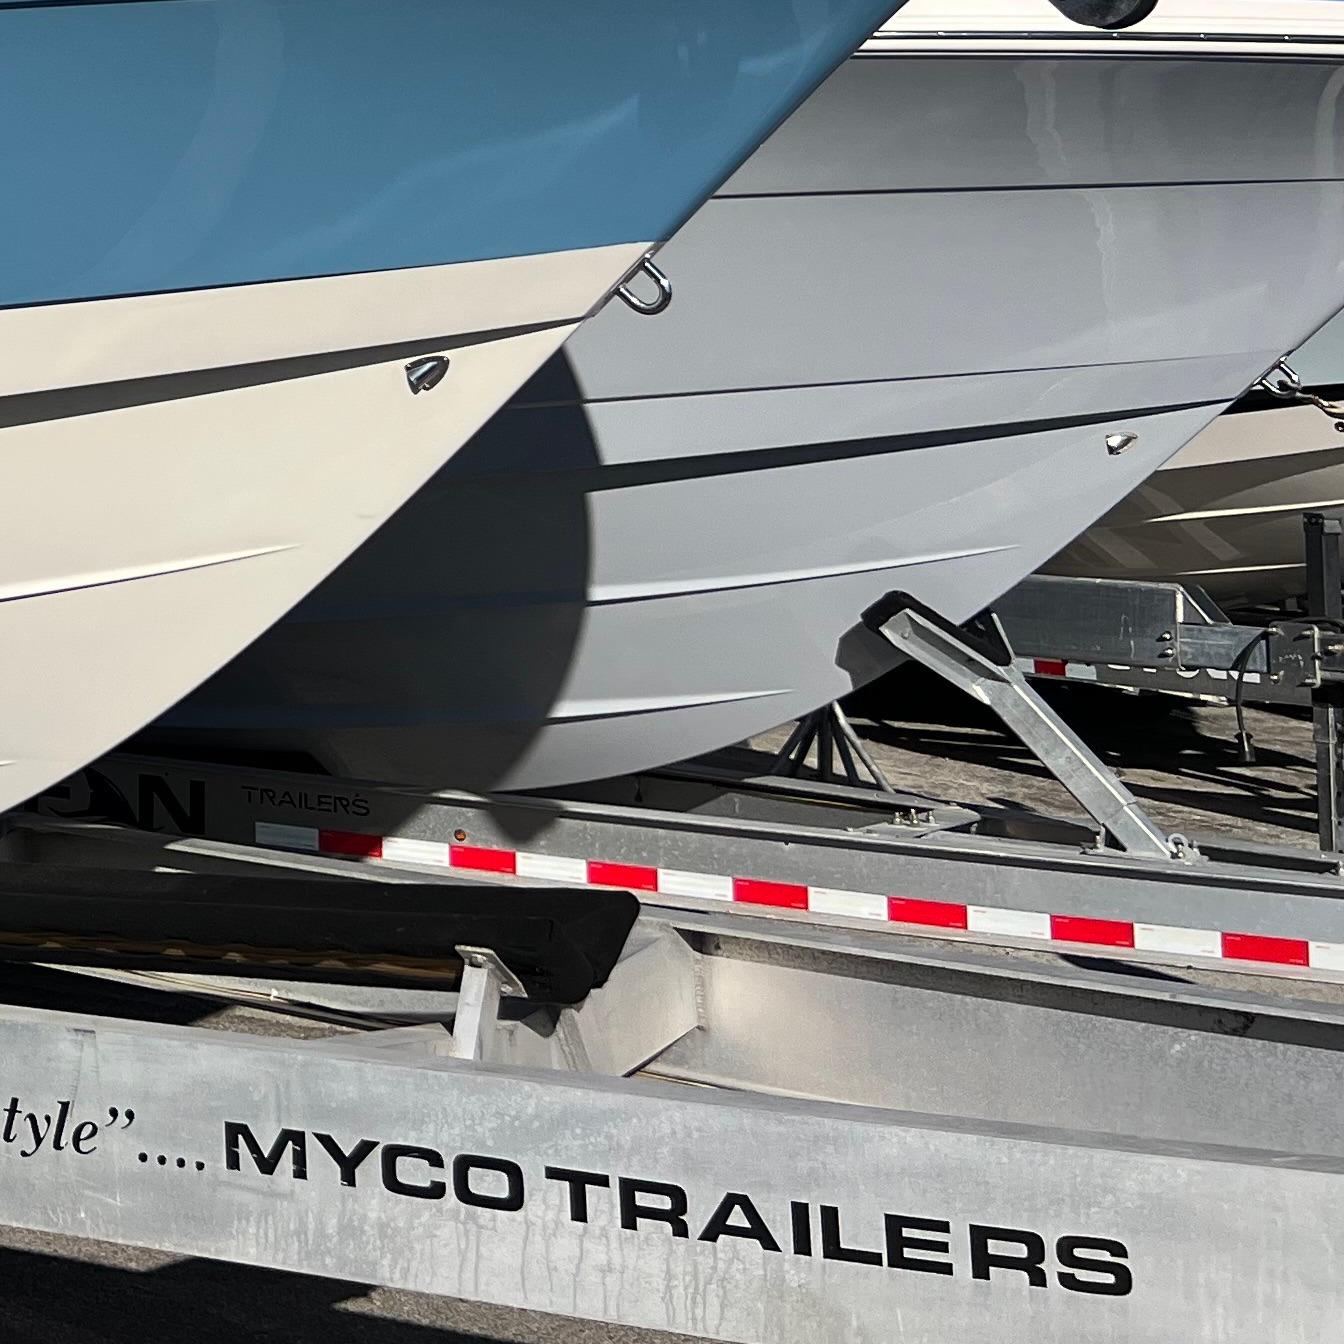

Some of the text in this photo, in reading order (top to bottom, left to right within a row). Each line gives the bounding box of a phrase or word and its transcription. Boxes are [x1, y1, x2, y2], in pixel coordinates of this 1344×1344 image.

[240, 784, 372, 818] TRAILERS
[223, 1120, 526, 1213] MYCO
[543, 1164, 1135, 1297] TRAILERS
